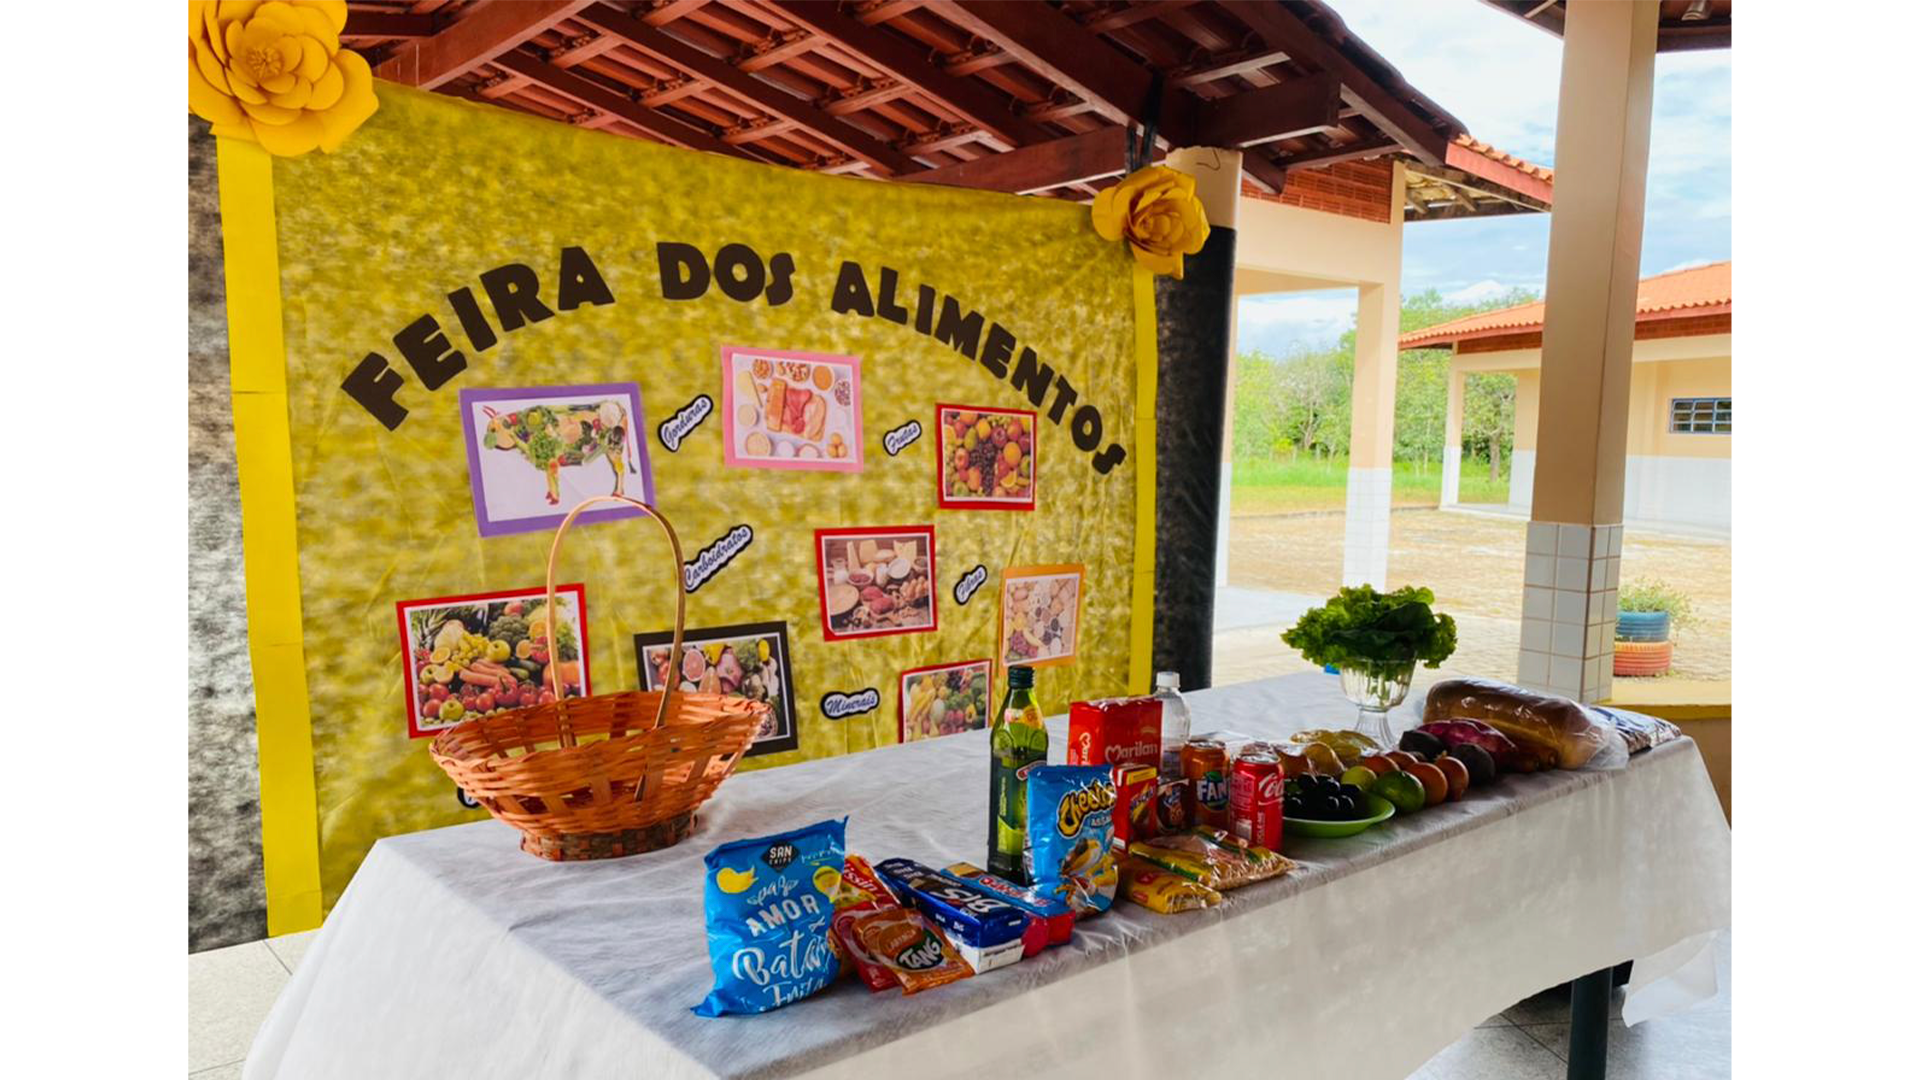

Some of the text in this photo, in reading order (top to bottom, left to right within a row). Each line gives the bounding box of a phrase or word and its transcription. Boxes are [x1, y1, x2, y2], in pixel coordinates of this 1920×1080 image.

[341, 241, 1127, 475] FEIRA DOS ALIMENTOS
[663, 398, 708, 449] Gorduras
[887, 424, 918, 452] Frutas
[684, 528, 748, 588] Carboidratos
[826, 696, 876, 714] Minerais
[1104, 741, 1159, 765] Marilan
[769, 845, 794, 860] SAN
[745, 894, 820, 938] AMOR
[898, 937, 940, 969] TANG
